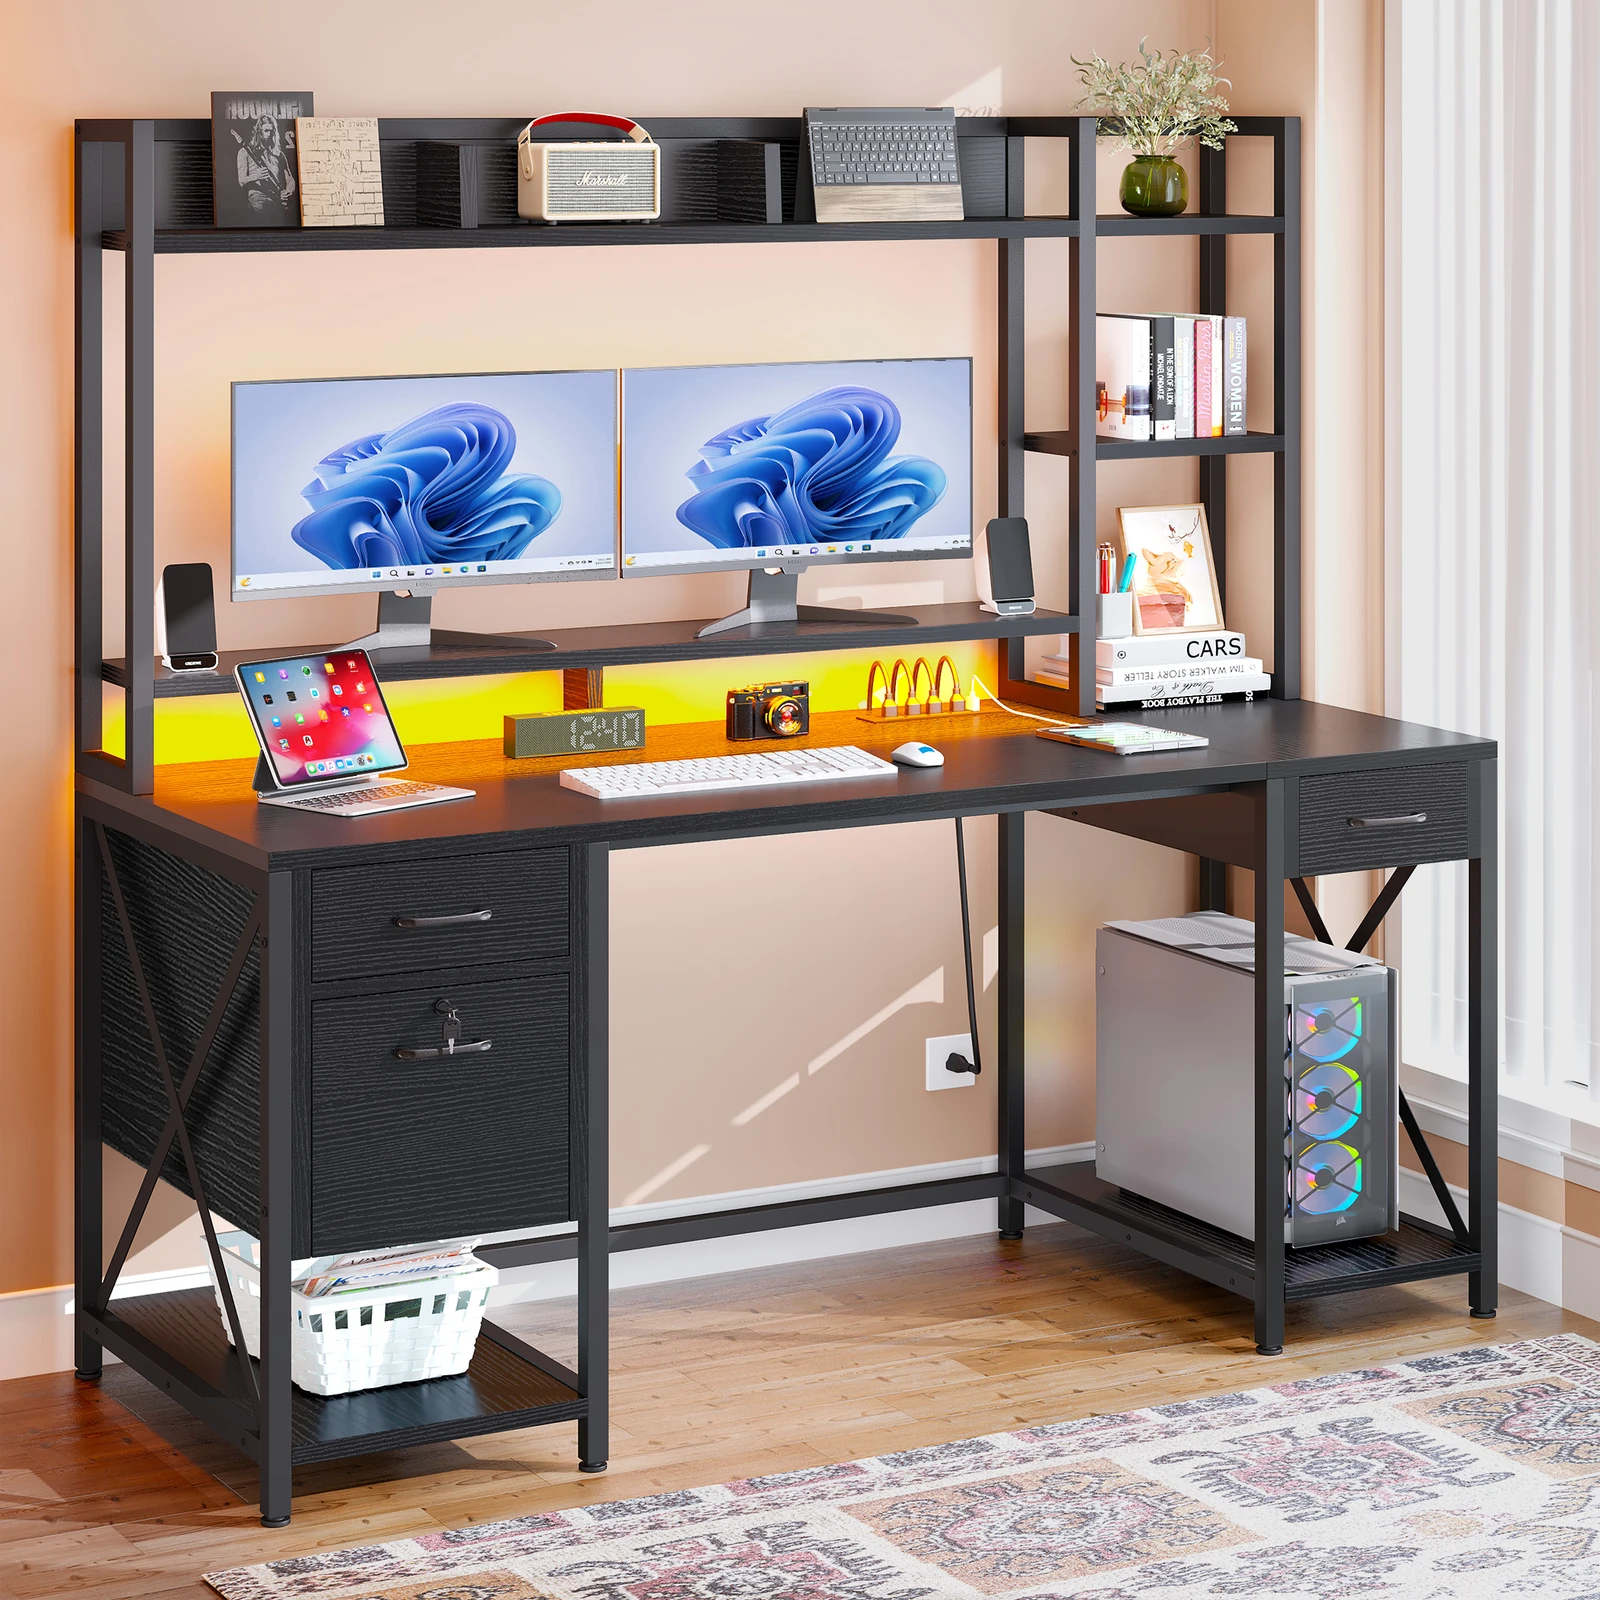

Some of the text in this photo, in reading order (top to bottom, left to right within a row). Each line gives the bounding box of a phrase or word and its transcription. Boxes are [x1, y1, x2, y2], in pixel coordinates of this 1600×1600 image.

[575, 170, 629, 187] Marshall
[1235, 321, 1243, 359] MODERN
[1166, 354, 1174, 365] THE
[1166, 366, 1174, 379] SKIN
[1197, 322, 1211, 420] Martin Parr
[1166, 392, 1174, 405] LION
[1230, 360, 1242, 422] WOMEN
[1186, 637, 1241, 659] CARS
[1124, 666, 1245, 682] TIM WALKER STORY TELLER
[1180, 681, 1215, 694] Death
[1141, 694, 1223, 709] THE PLAYBOY BOOK
[570, 712, 640, 750] 12:40
